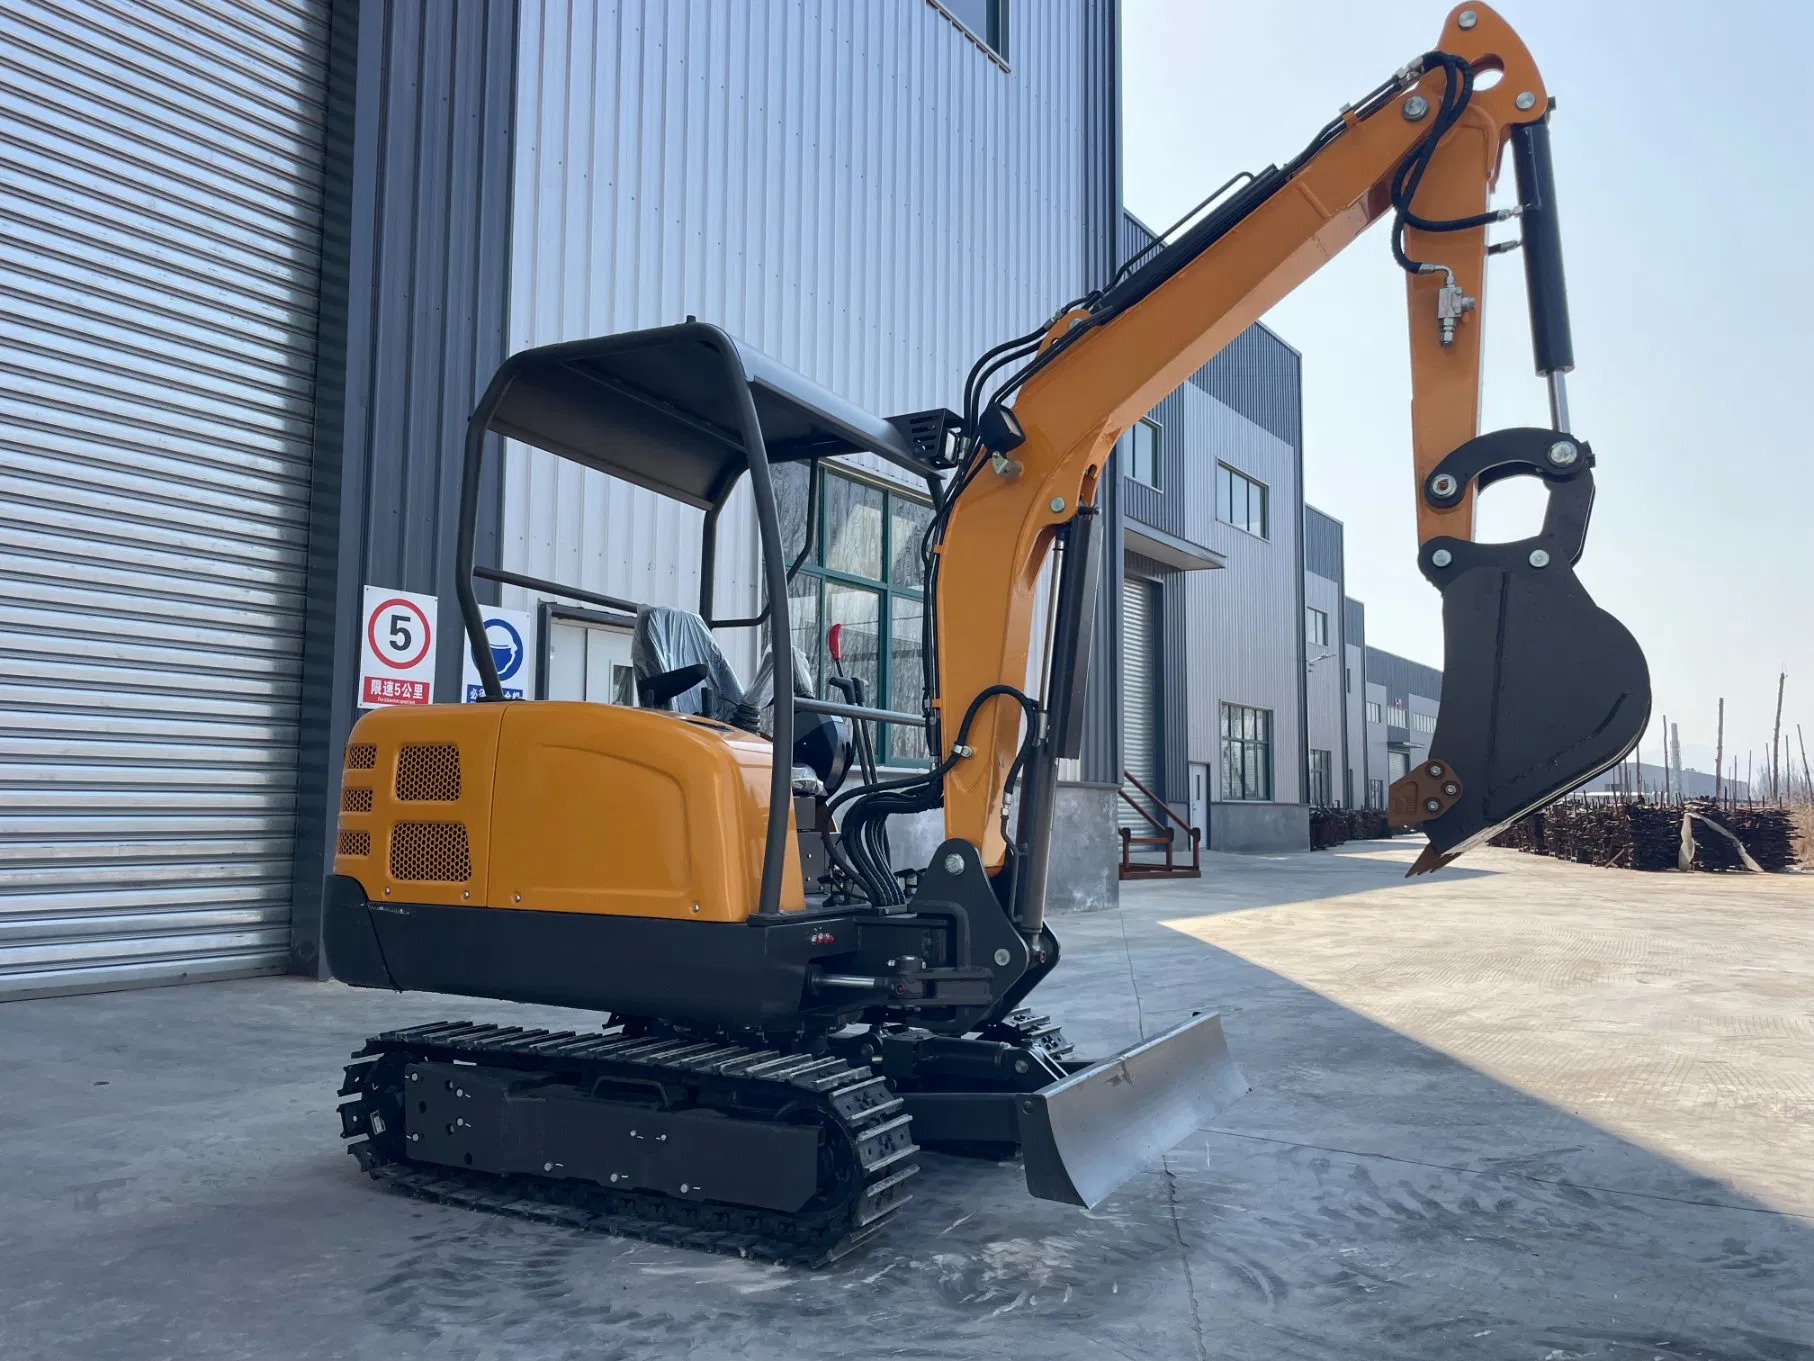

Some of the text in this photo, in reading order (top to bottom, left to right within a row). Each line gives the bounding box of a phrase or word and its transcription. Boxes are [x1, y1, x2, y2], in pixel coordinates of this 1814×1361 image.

[389, 614, 412, 651] 5
[370, 679, 424, 699] 限速5公里
